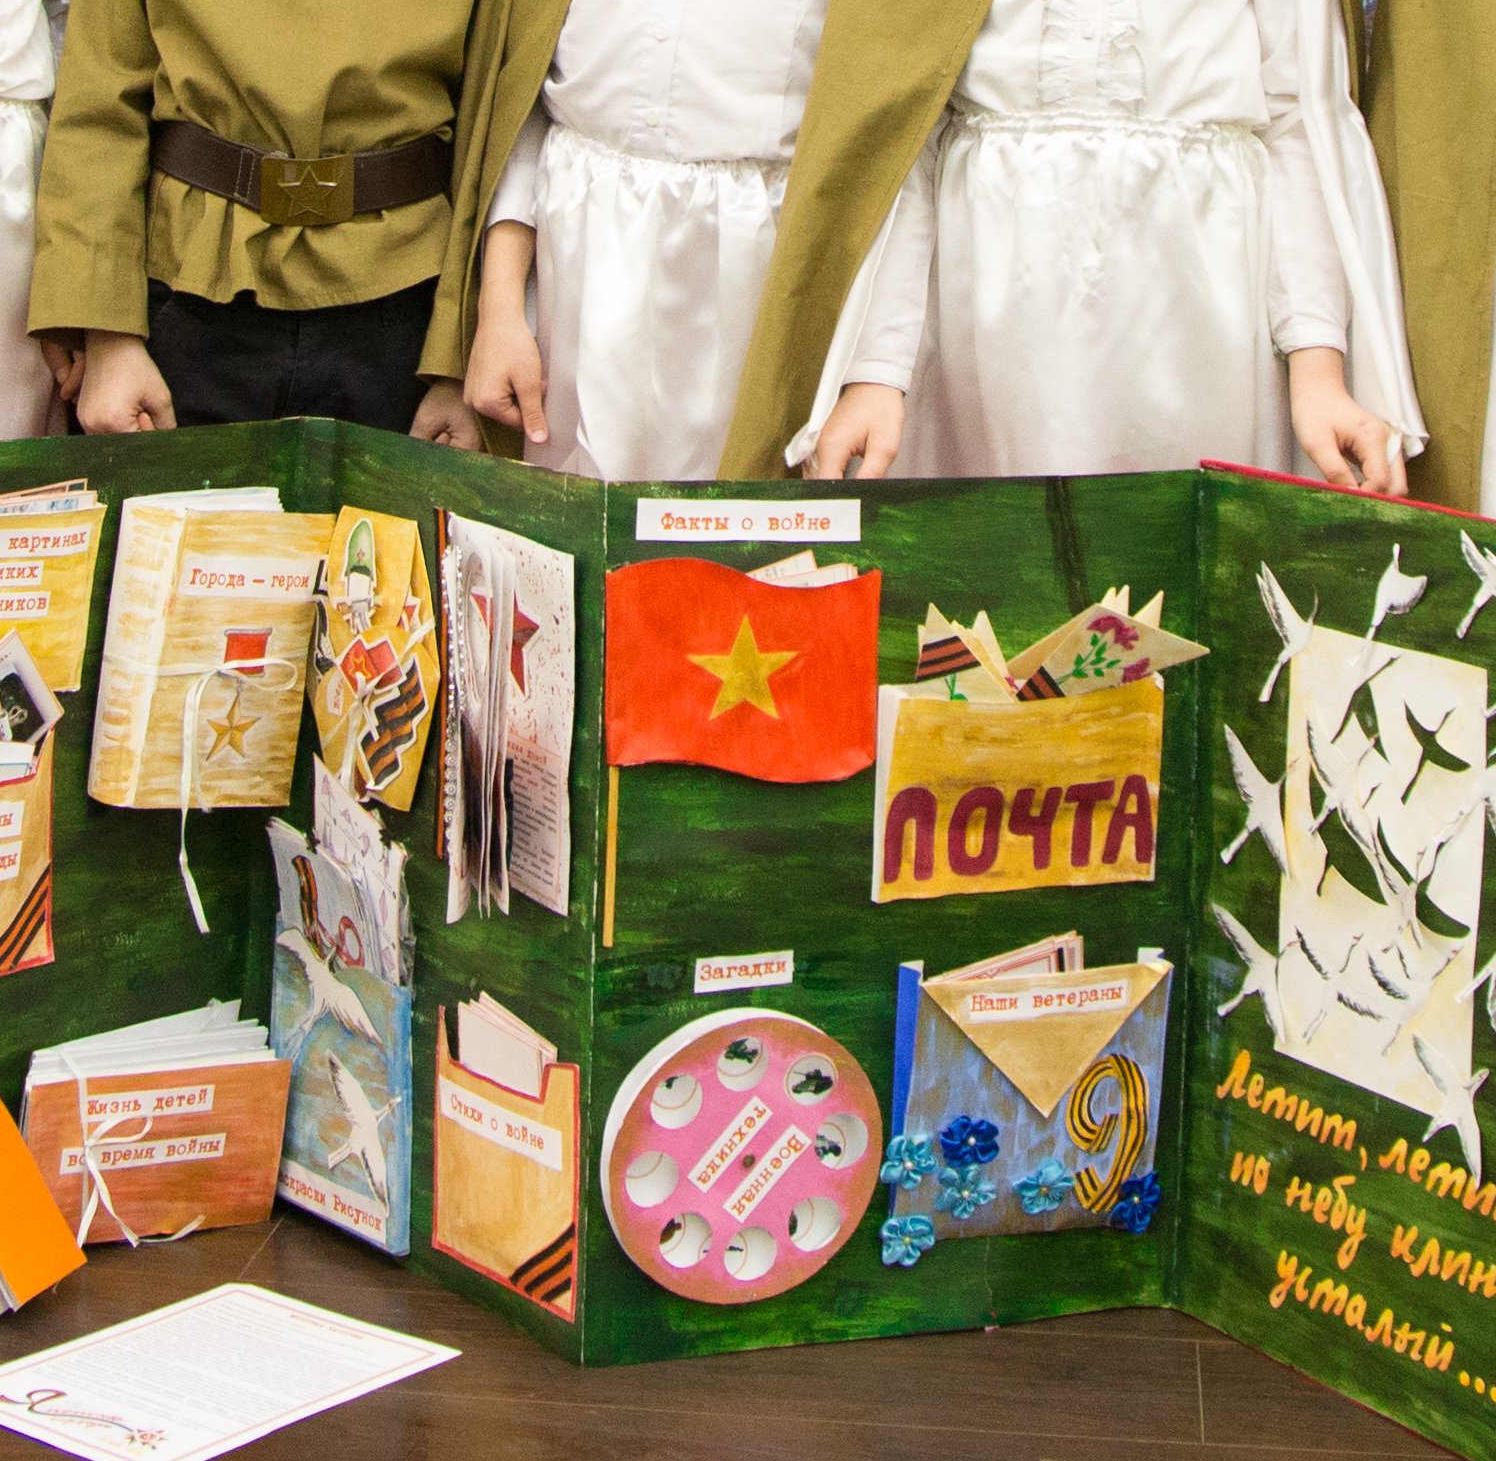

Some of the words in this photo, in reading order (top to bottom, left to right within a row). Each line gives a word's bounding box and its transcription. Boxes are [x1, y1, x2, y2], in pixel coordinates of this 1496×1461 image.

[661, 512, 729, 531] Факты
[742, 517, 753, 530] о
[768, 513, 831, 531] войне
[8, 531, 87, 552] картинах
[190, 568, 246, 589] Города
[271, 574, 310, 591] герои
[883, 774, 1155, 884] ПОЧТА
[700, 959, 787, 982] Загадки
[971, 994, 1019, 1013] Наши
[1032, 985, 1124, 1009] ветераны
[87, 1099, 142, 1116] Жизнь
[153, 1088, 208, 1112] детей
[1217, 1049, 1368, 1171] Летит,
[451, 1094, 483, 1125] Стихи
[491, 1118, 498, 1131] о
[506, 1123, 544, 1149] войне
[101, 1147, 155, 1165] время
[166, 1138, 221, 1158] войны
[697, 1105, 766, 1186] техника
[733, 1133, 807, 1216] Военная
[333, 1194, 382, 1231] Рисунок
[1231, 1152, 1270, 1194] по
[1286, 1175, 1367, 1269] небу
